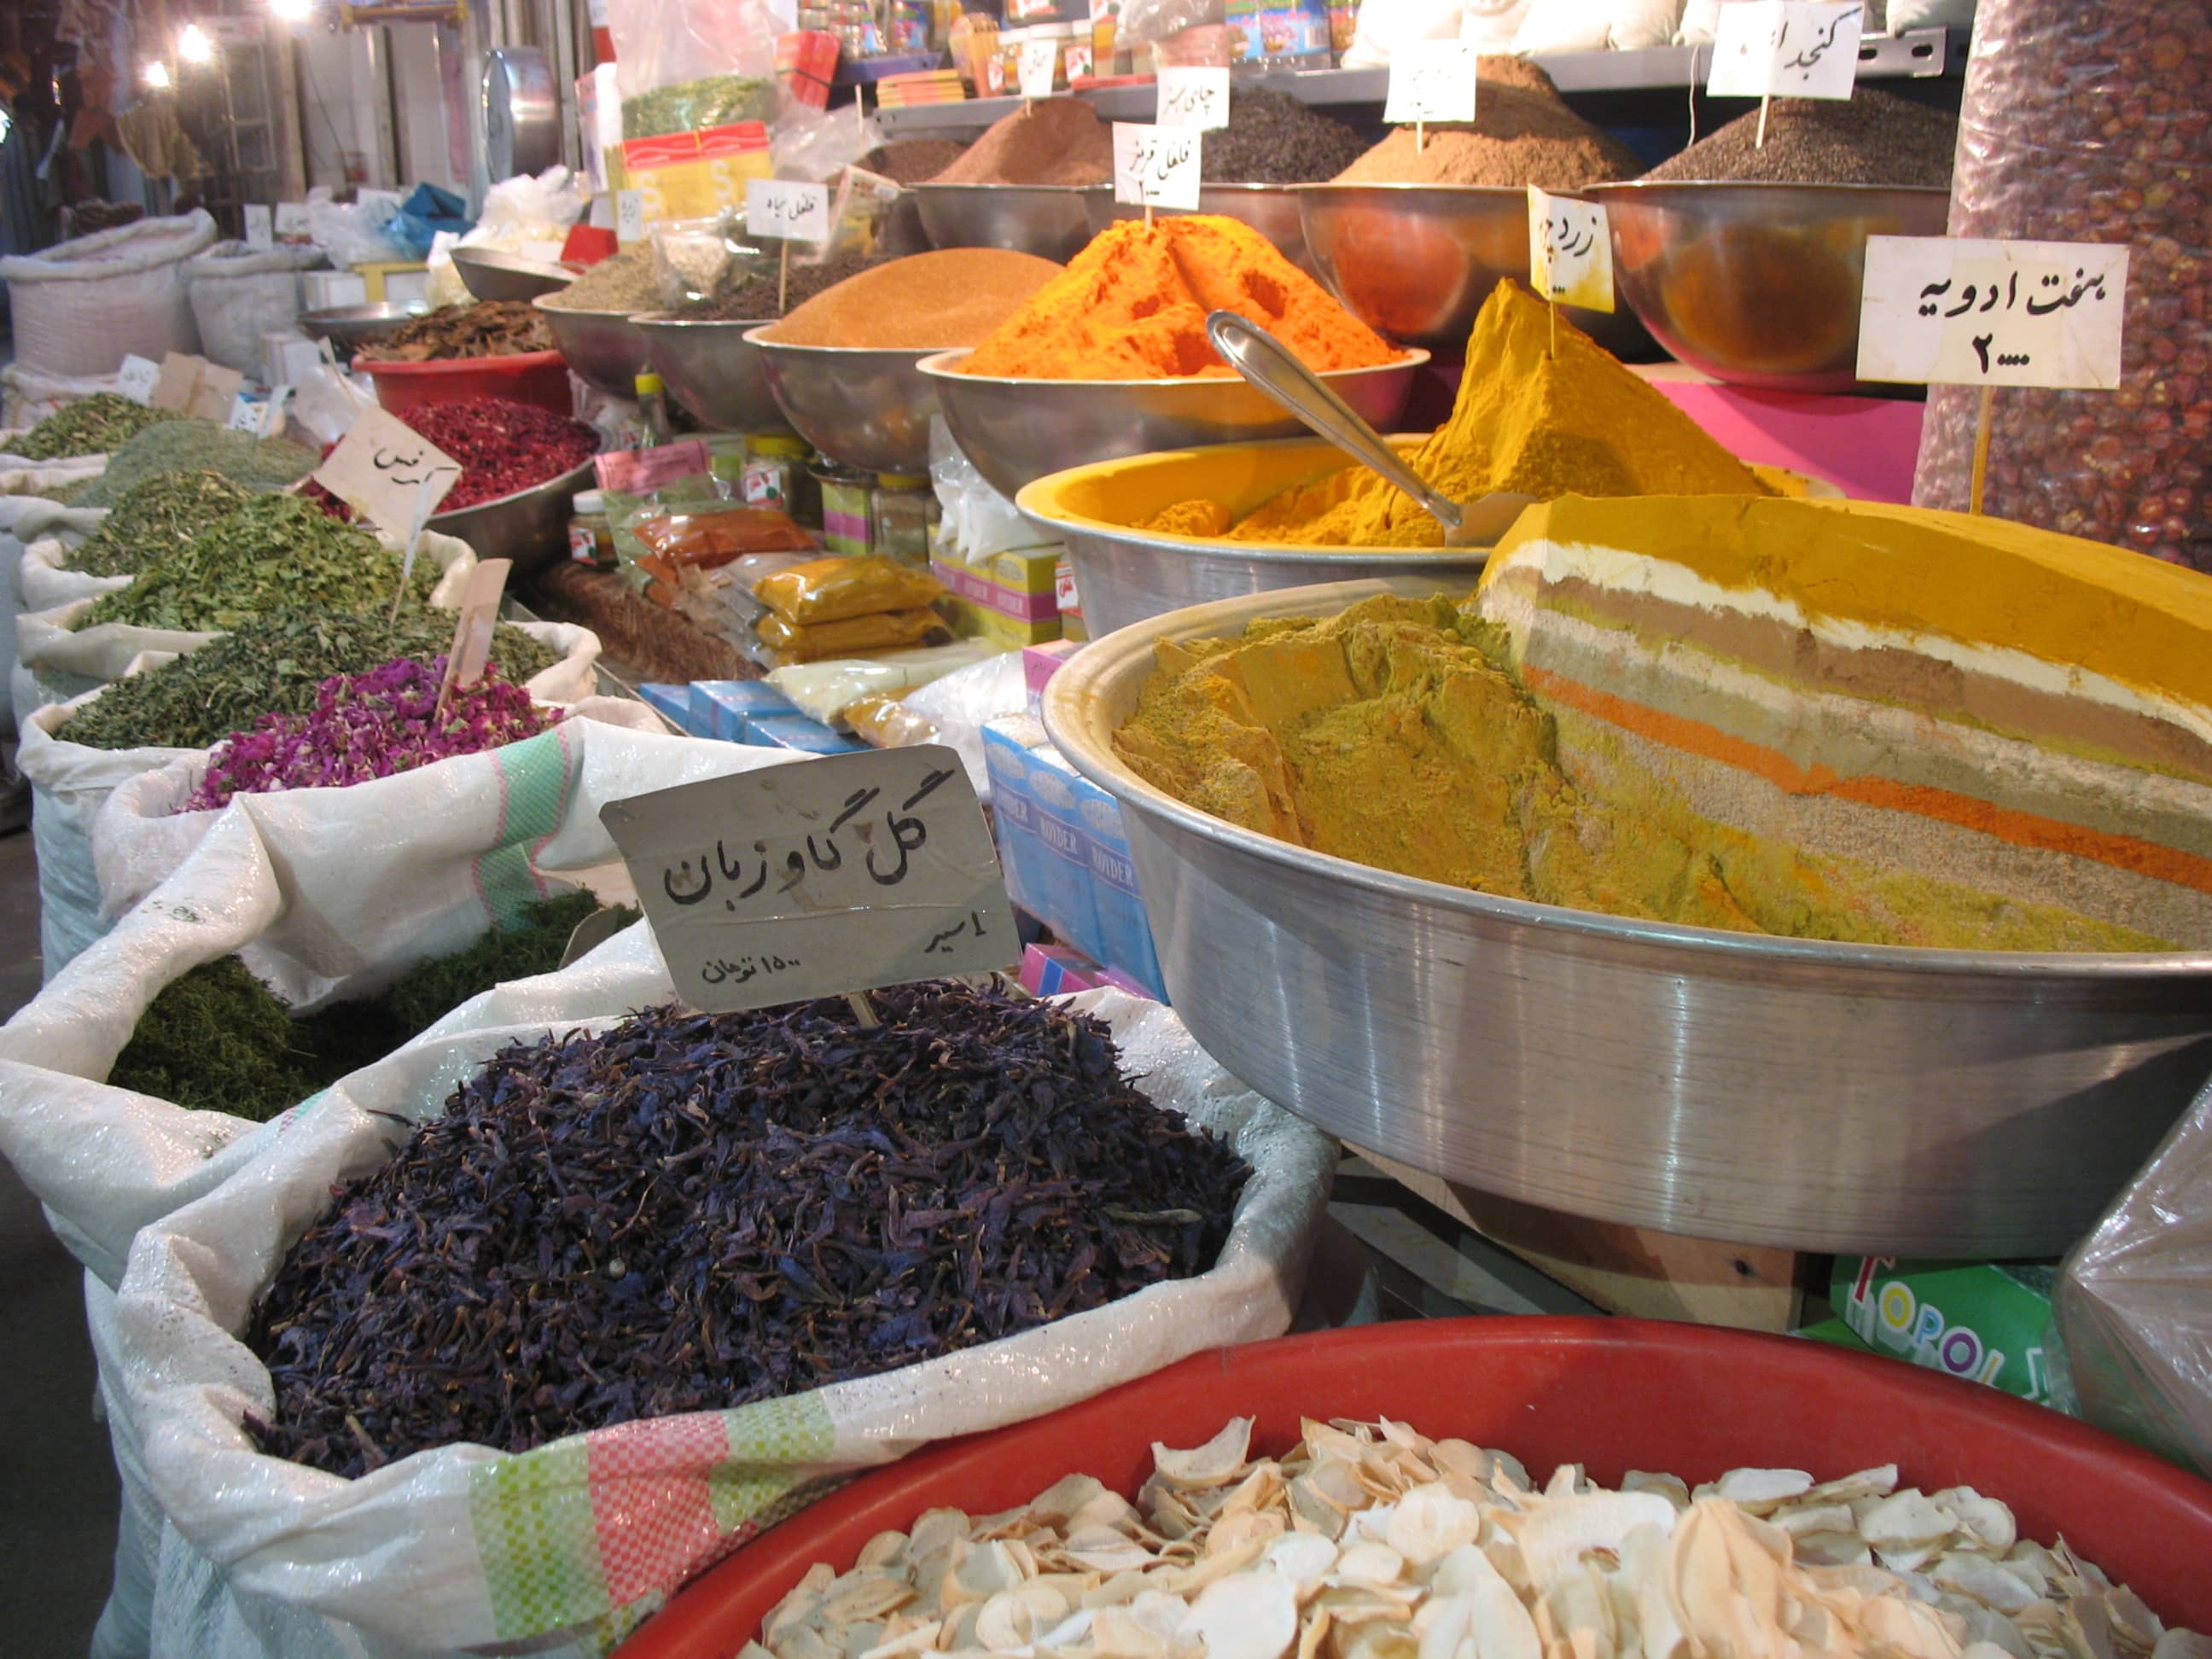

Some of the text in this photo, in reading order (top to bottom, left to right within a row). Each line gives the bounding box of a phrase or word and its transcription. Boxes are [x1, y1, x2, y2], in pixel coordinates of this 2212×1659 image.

[1784, 6, 1863, 81] کنجد
[1130, 139, 1191, 180] فلفل قرمز
[767, 192, 818, 221] فلفل سیاه
[1918, 267, 2106, 318] هفت ادویه
[1971, 332, 2030, 374] ۲۰۰۰۰
[866, 769, 955, 886] گل
[924, 921, 965, 953] سیر
[701, 957, 757, 983] تومان
